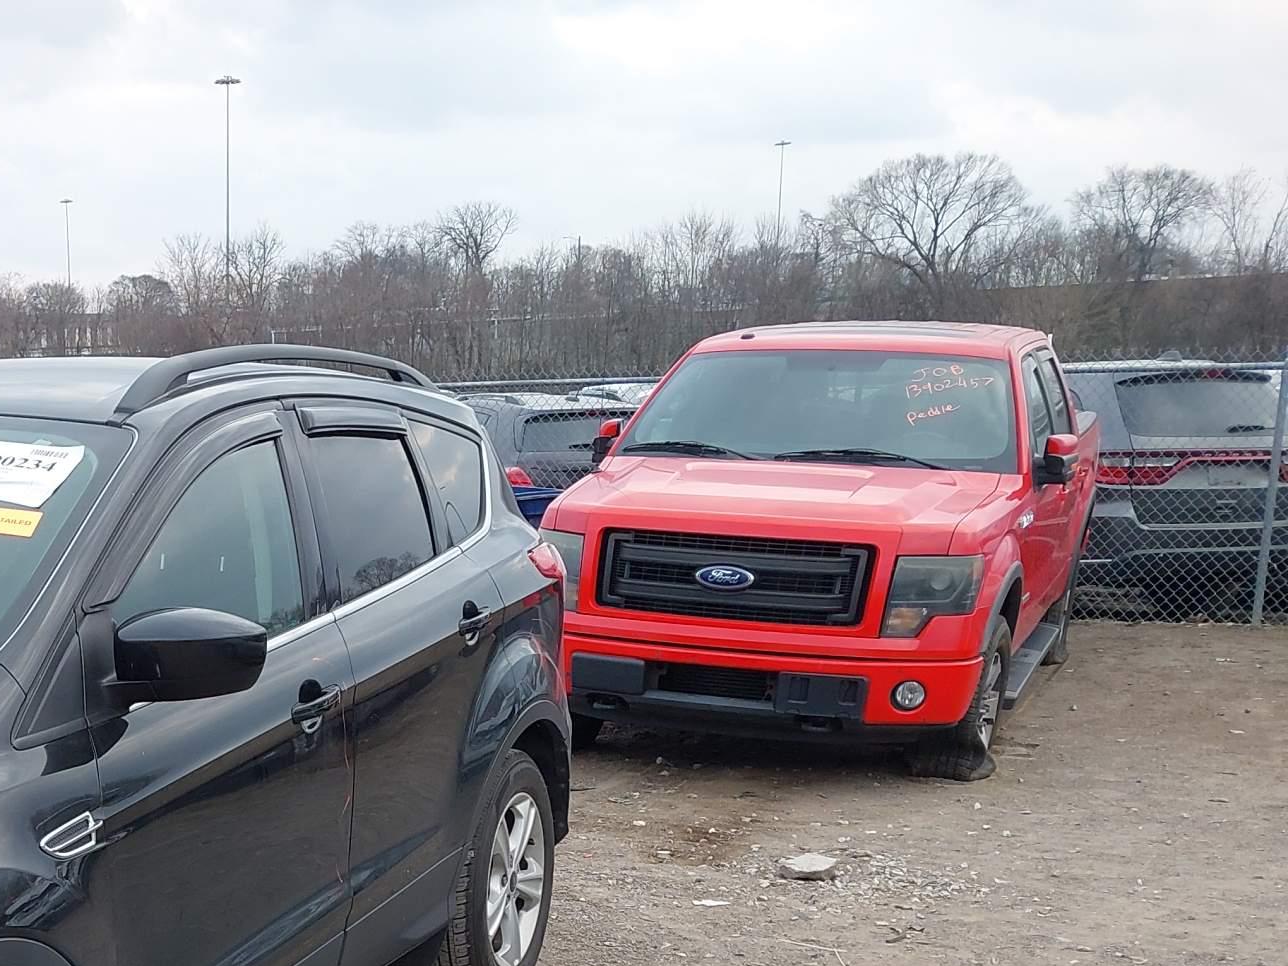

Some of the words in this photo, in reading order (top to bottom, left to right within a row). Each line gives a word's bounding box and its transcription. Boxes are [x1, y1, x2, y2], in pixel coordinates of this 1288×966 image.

[911, 364, 964, 382] JOB
[905, 376, 995, 400] 13902457
[707, 568, 742, 584] Ford
